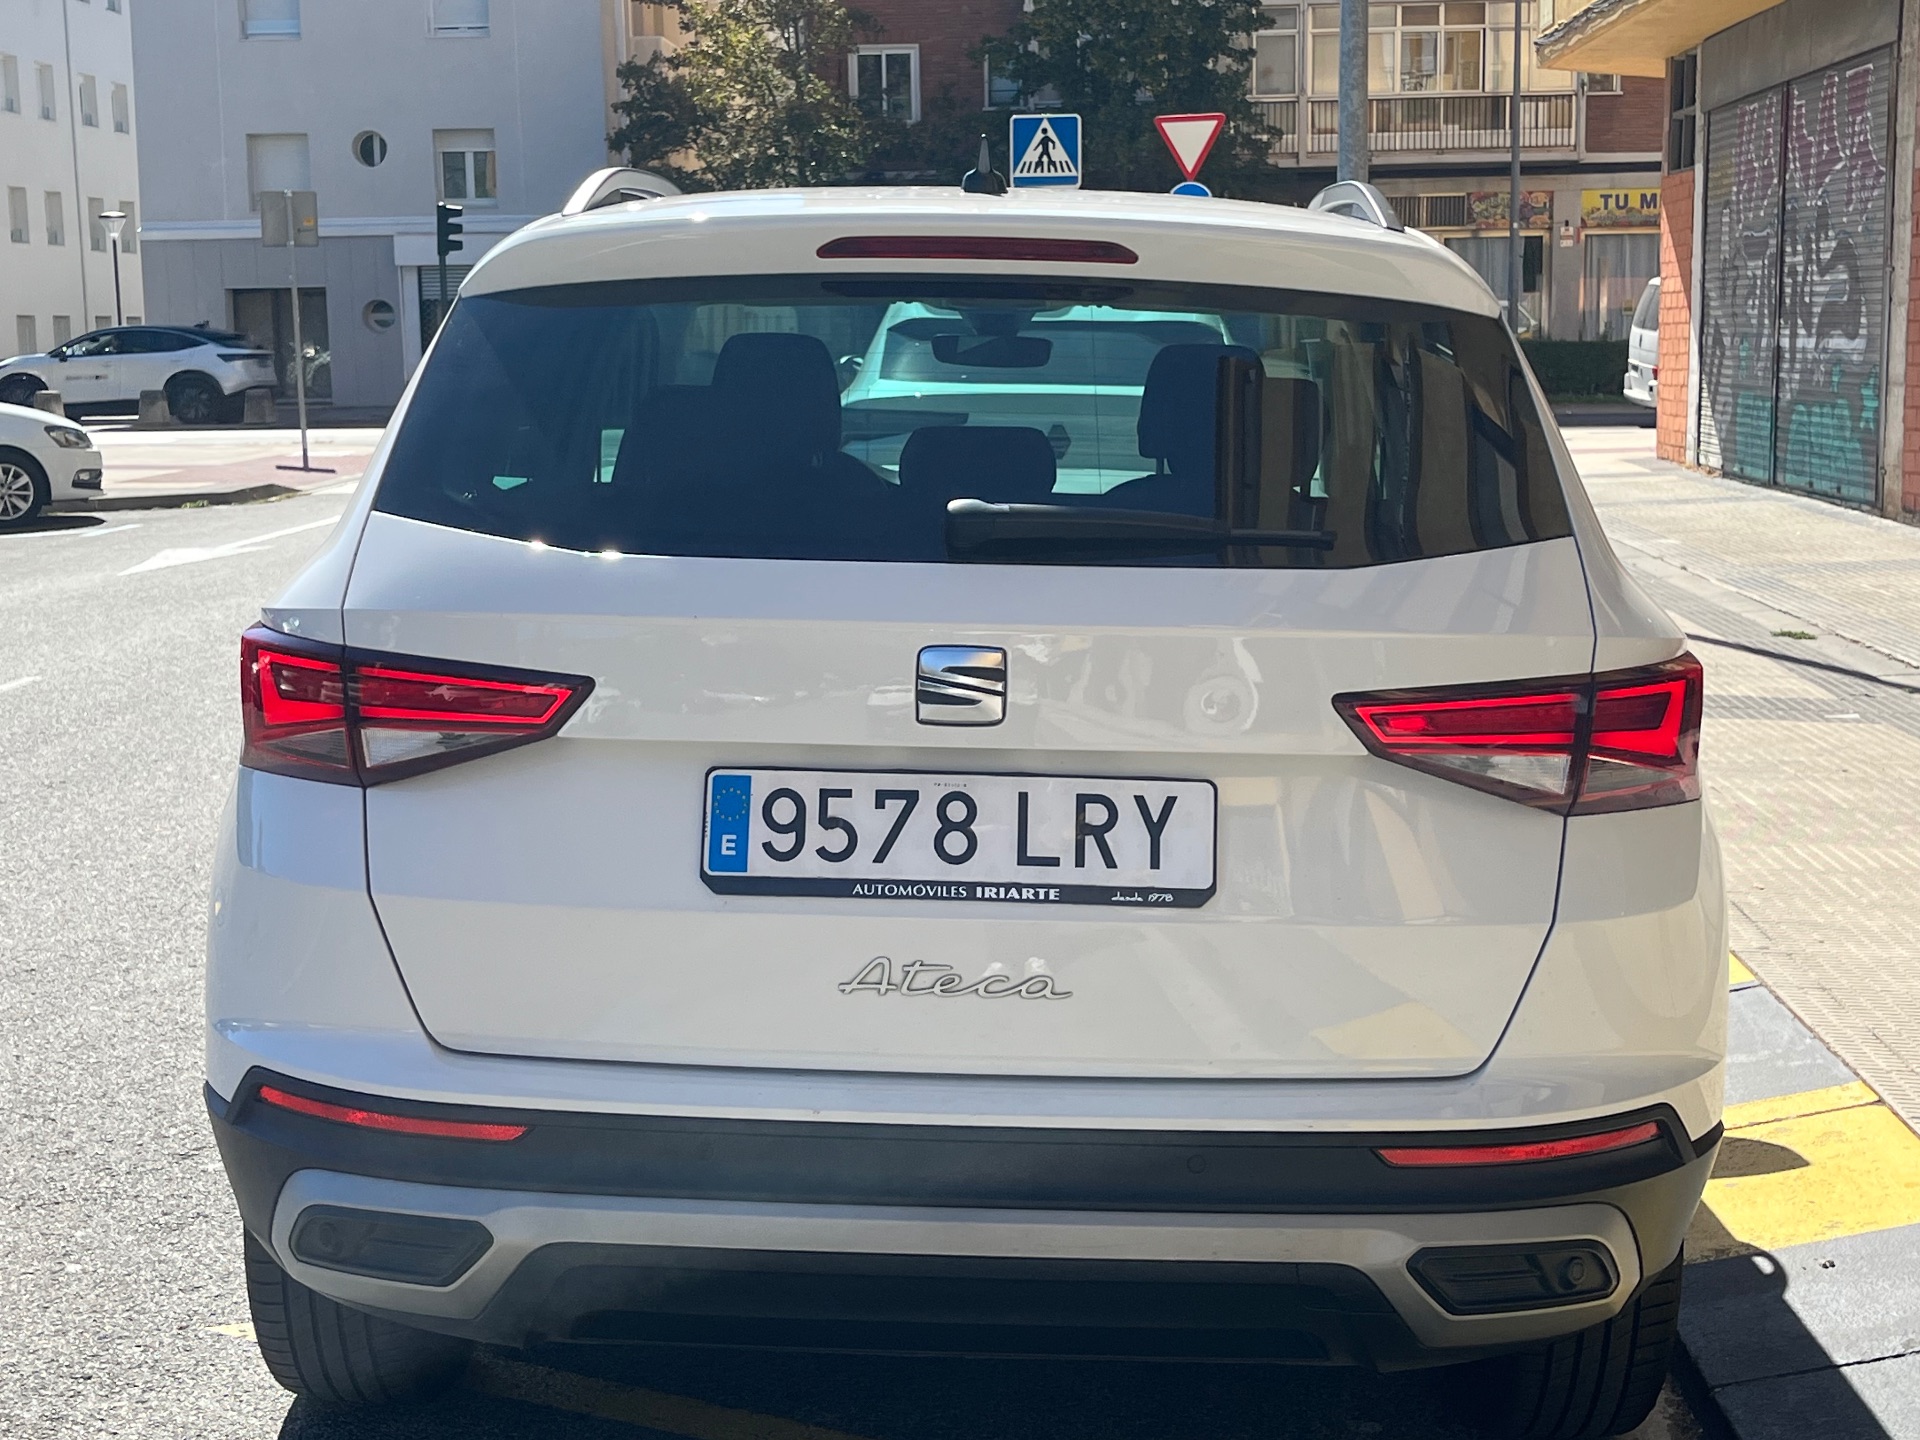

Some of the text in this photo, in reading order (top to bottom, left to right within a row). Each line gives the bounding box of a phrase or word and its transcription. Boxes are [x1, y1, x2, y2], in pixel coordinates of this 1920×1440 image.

[1599, 193, 1629, 211] TU
[761, 787, 1179, 870] 9578 LRY
[721, 834, 738, 856] E
[975, 886, 1061, 901] IRIARTE
[838, 956, 1074, 1000] Ateca
